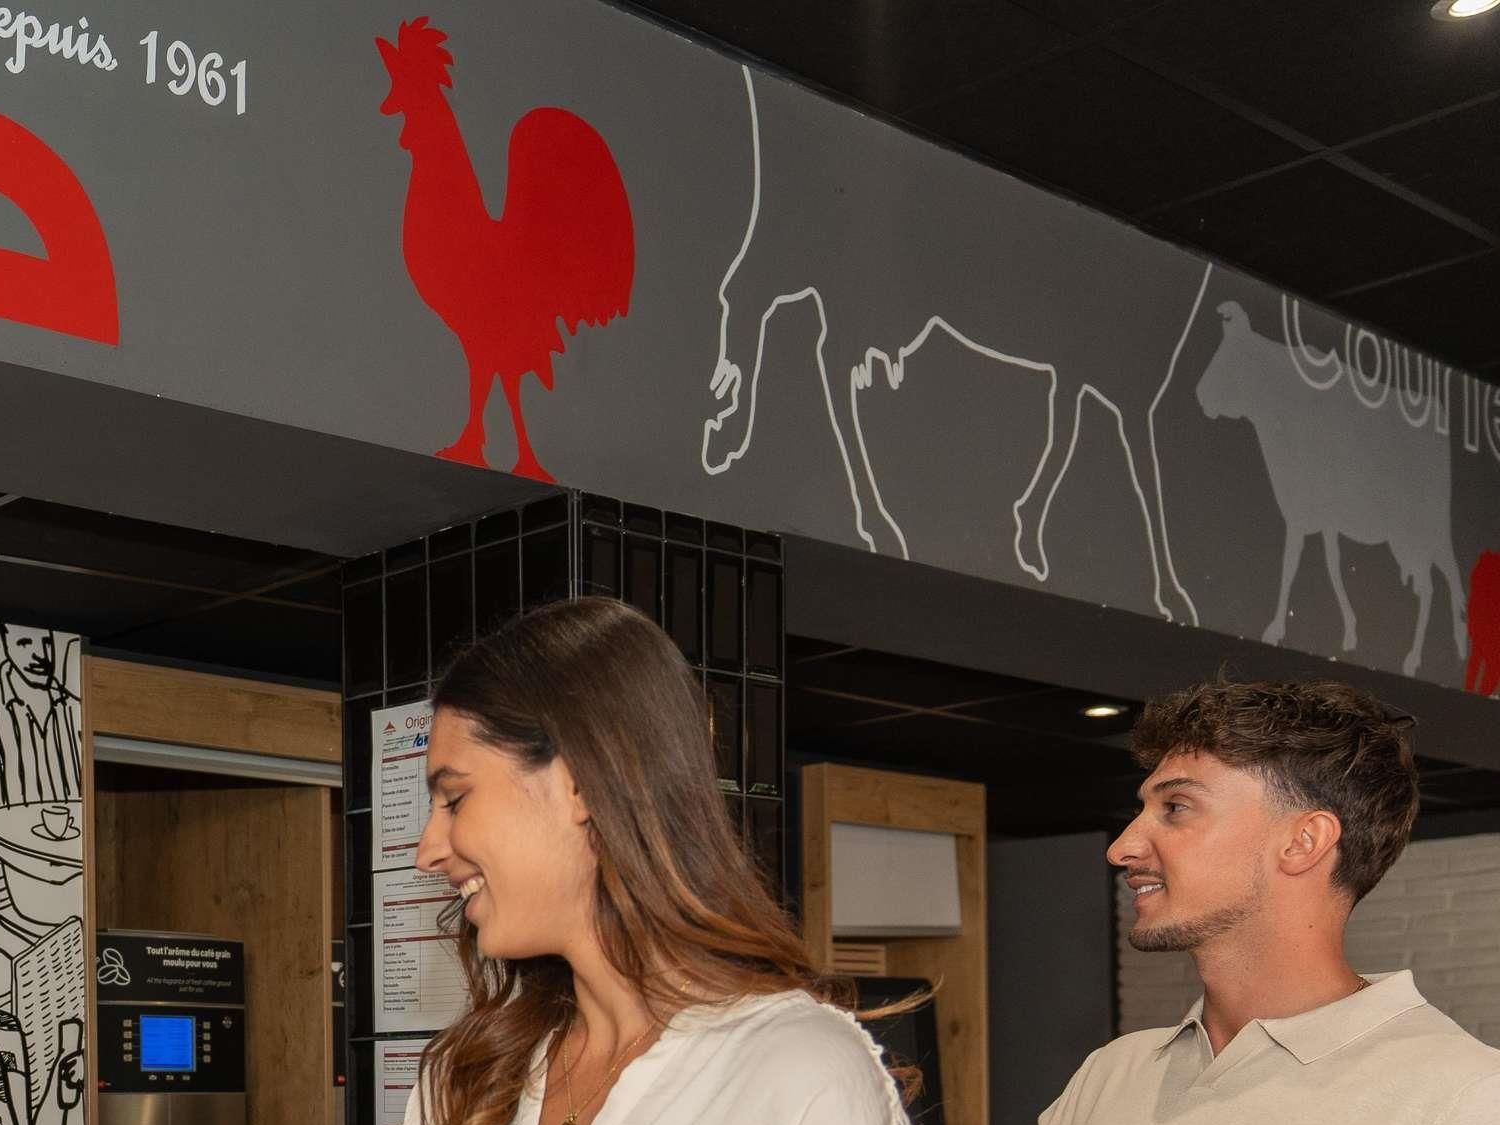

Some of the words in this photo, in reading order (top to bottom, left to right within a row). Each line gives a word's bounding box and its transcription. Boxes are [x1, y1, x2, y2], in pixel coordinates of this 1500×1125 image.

[140, 31, 247, 115] 1961
[405, 715, 433, 729] Origin
[146, 946, 164, 955] Tout
[191, 948, 200, 957] du
[200, 948, 214, 958] café
[215, 950, 231, 960] grain
[163, 958, 185, 968] moulu
[186, 960, 201, 969] pour
[202, 961, 218, 969] vous
